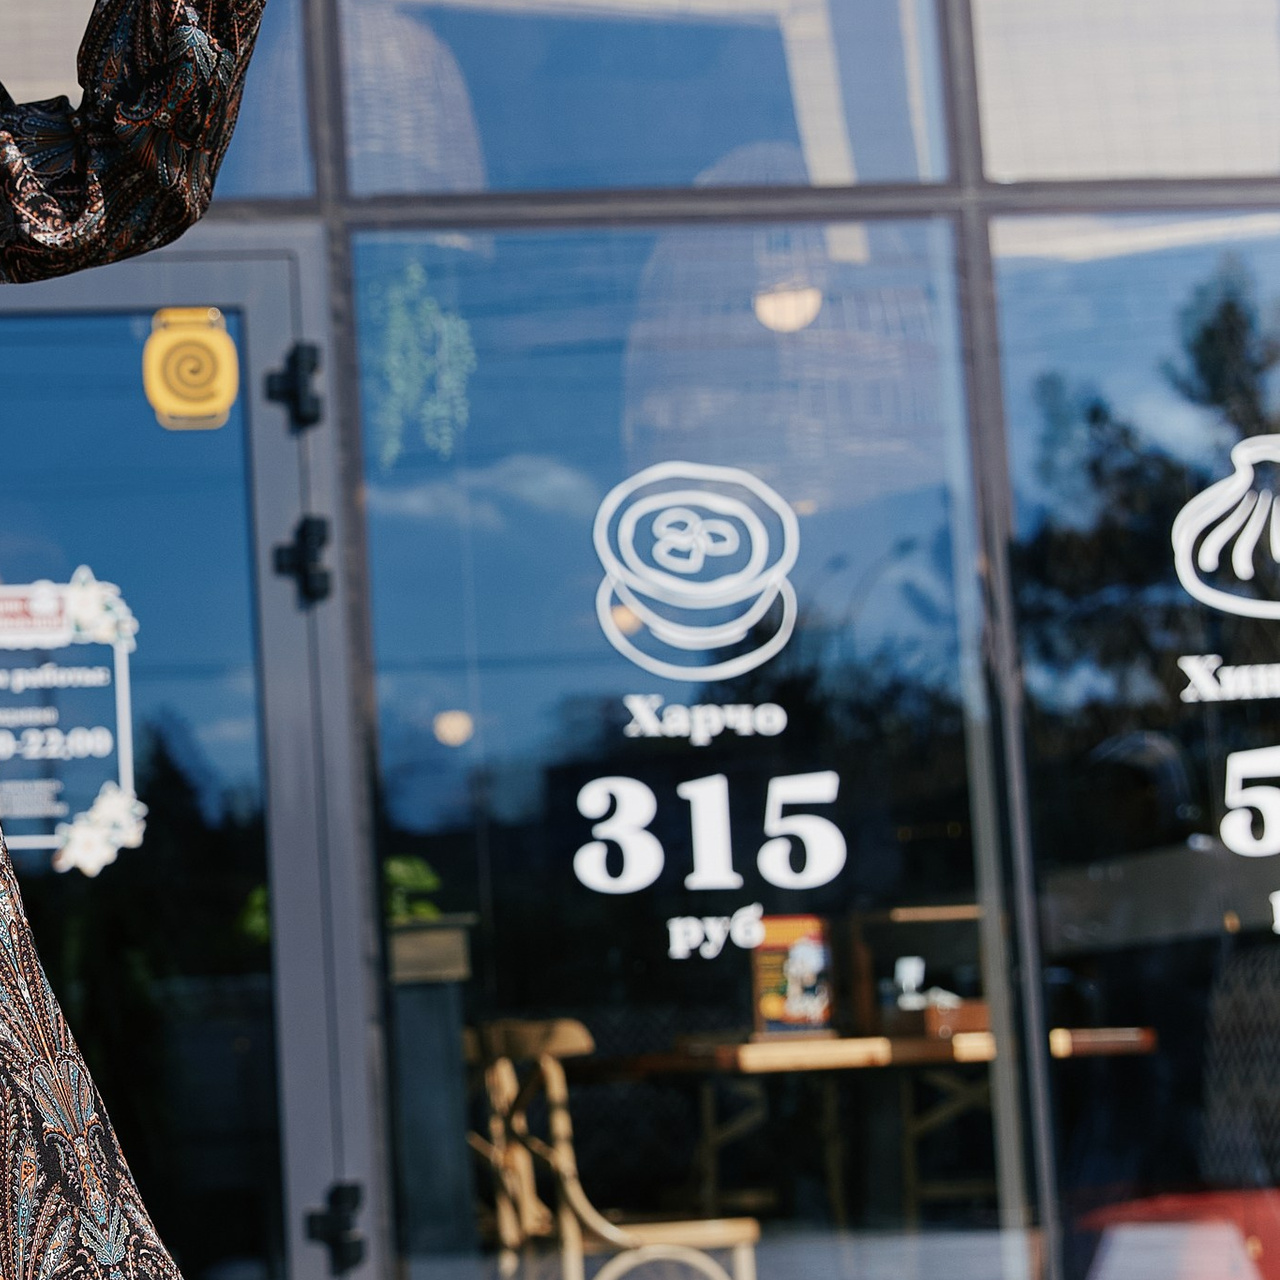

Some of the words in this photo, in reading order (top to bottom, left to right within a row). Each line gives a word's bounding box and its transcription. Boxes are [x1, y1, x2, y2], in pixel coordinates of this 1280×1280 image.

[622, 693, 788, 745] Харчо
[573, 770, 847, 895] 315
[666, 901, 766, 960] руб
